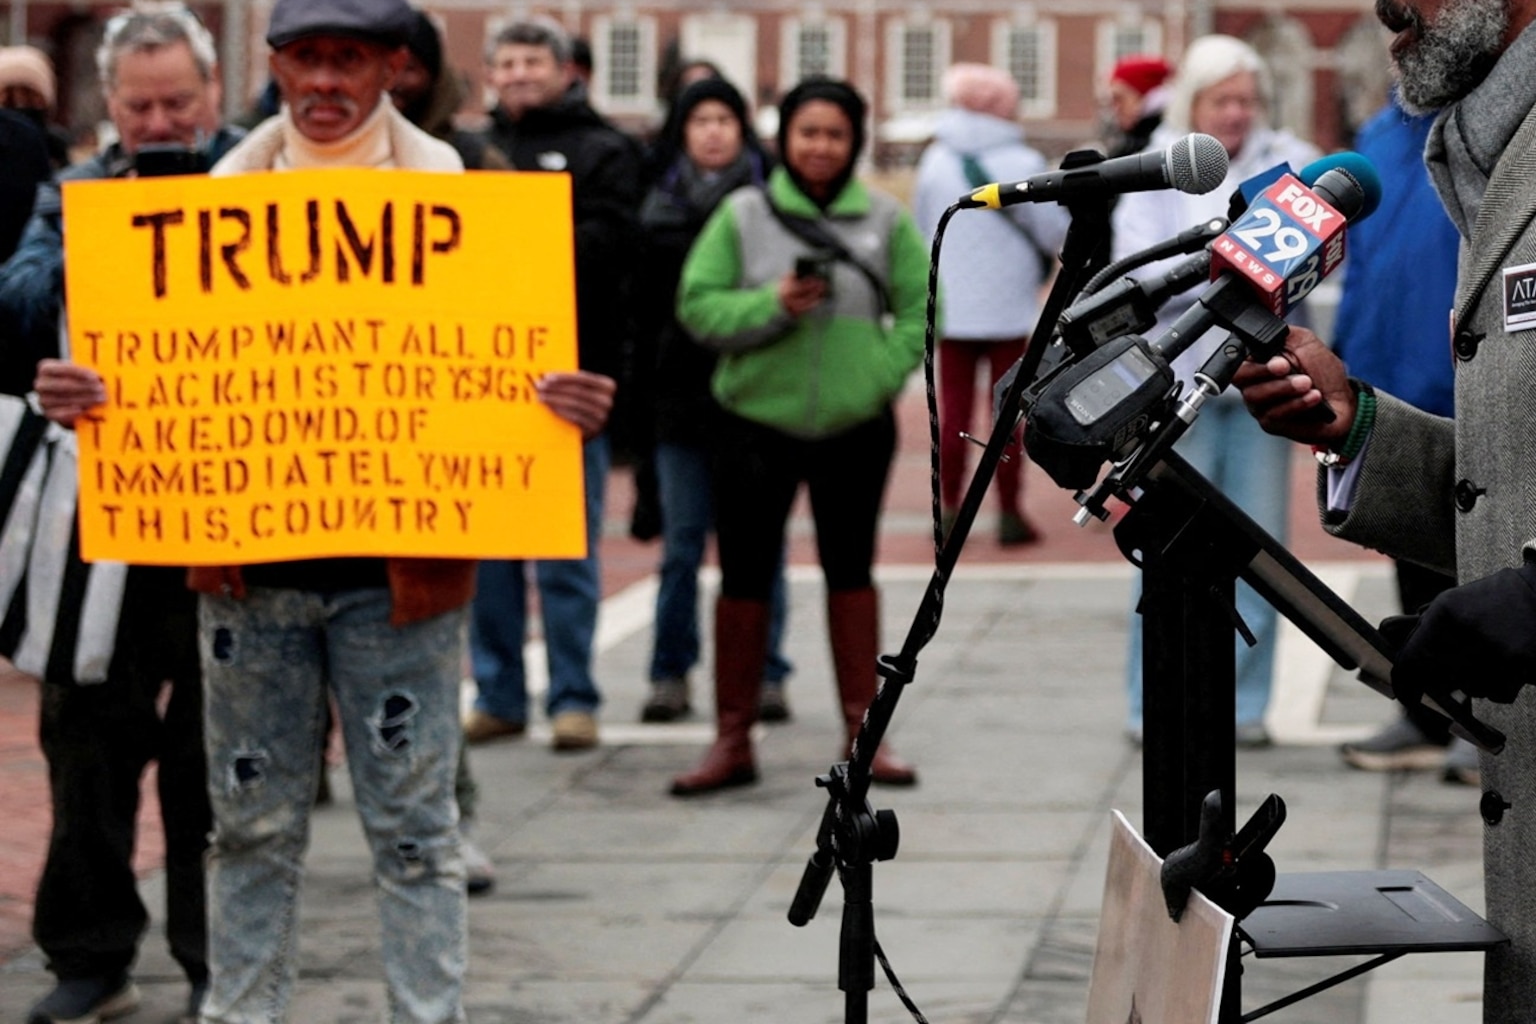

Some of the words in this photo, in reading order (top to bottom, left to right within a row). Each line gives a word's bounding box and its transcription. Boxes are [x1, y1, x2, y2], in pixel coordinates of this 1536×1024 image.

[1276, 184, 1334, 234] FOX
[131, 198, 462, 299] TRUMP
[1232, 207, 1309, 263] 29
[1325, 229, 1344, 274] FOX
[1219, 239, 1276, 285] NEWS
[1287, 254, 1320, 305] 29
[84, 326, 255, 366] TRUMP
[265, 319, 386, 356] WANT
[401, 323, 476, 359] ALL
[493, 323, 549, 362] OF
[375, 406, 428, 444] OF
[441, 453, 535, 490] WHY
[250, 497, 473, 540] COUNTRY
